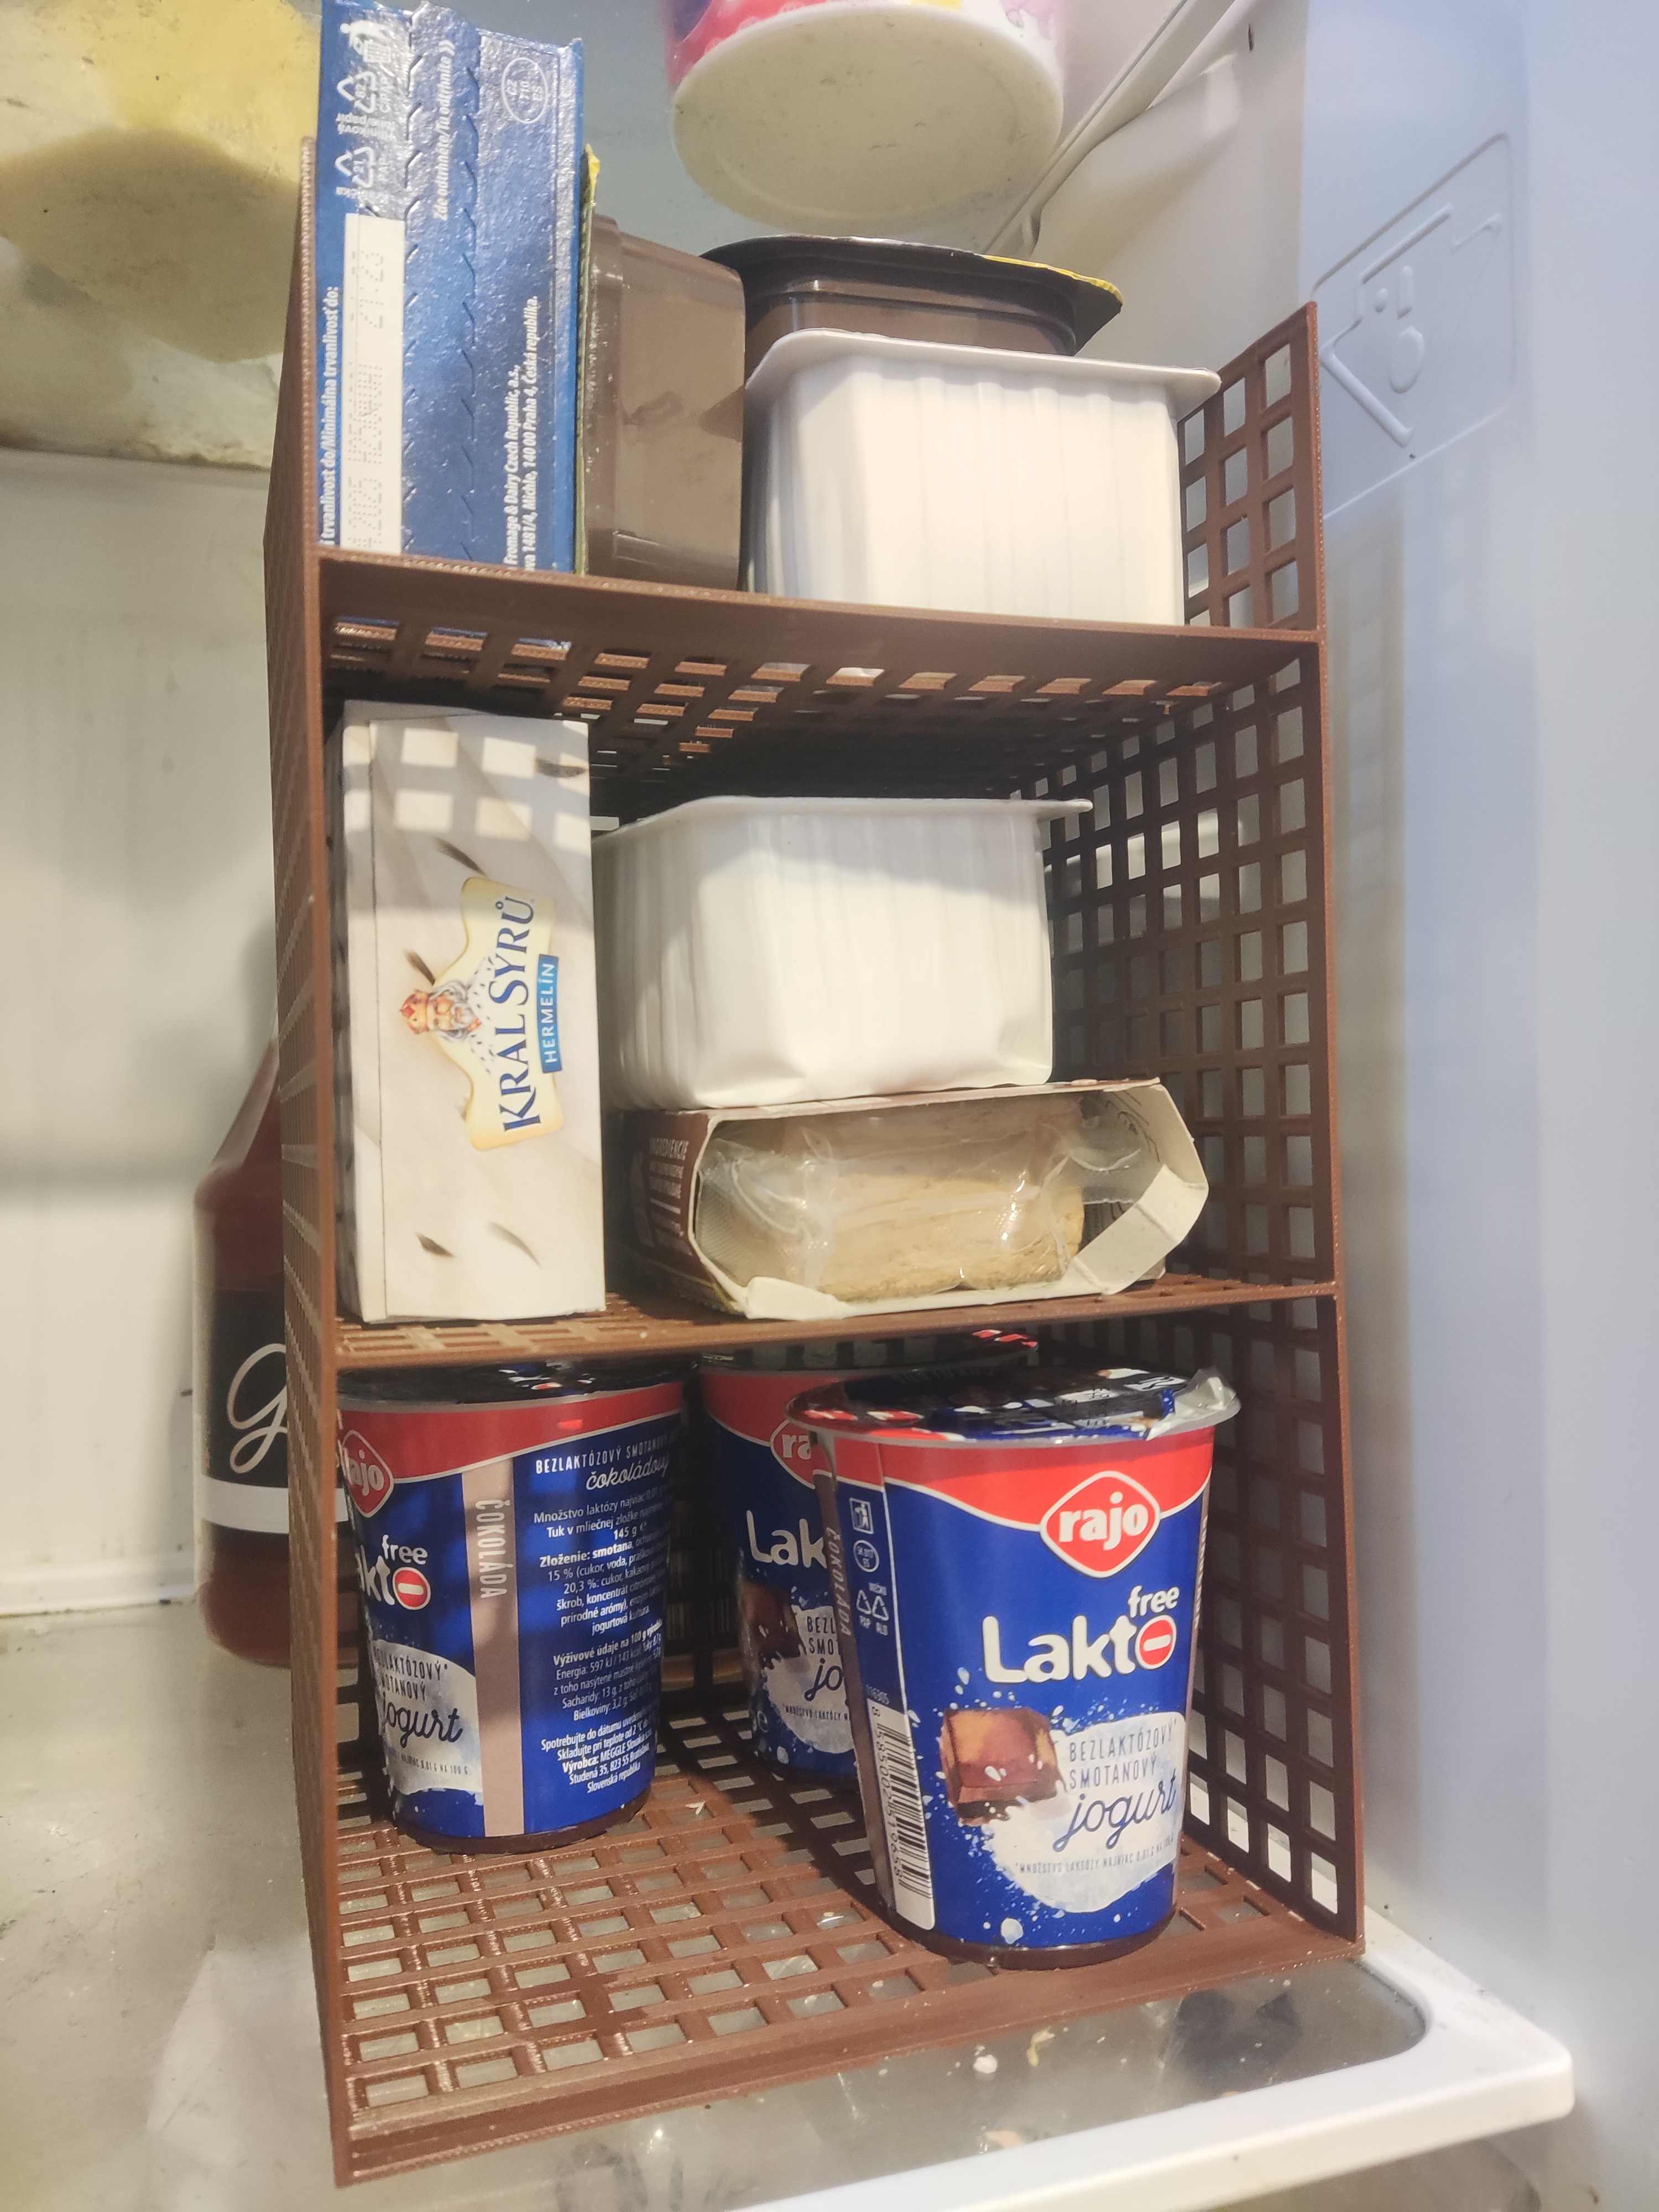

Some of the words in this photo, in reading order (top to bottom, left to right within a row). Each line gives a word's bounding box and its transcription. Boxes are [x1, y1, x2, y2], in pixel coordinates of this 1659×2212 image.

[433, 199, 448, 221] Zde
[523, 296, 541, 351] republika.
[521, 352, 538, 384] Česká
[504, 389, 521, 440] Republic,
[522, 398, 537, 430] Praha
[522, 430, 536, 447] 00
[504, 441, 519, 473] Czech
[522, 447, 536, 468] 140
[320, 469, 336, 538] trvanlivost
[504, 475, 521, 503] Dairy
[521, 470, 539, 510] Michle,
[504, 516, 520, 565] Fromage
[539, 962, 557, 1064] HERMELÍN
[343, 1447, 384, 1496] ajo
[535, 1446, 622, 1474] BEZLAKTÓZOVÝ
[534, 1509, 584, 1524] Množstvo
[586, 1501, 618, 1516] laktózy
[546, 1525, 565, 1538] Tuk
[567, 1526, 573, 1535] v
[576, 1519, 614, 1535] mliečnej
[1058, 1491, 1149, 1551] rajo
[381, 1533, 429, 1566] free
[474, 1499, 514, 1599] ČOKOLÁDA
[613, 1527, 629, 1541] 145
[632, 1526, 637, 1537] g
[539, 1550, 591, 1568] Zloženie:
[547, 1571, 560, 1582] 15
[563, 1568, 574, 1579] %
[606, 1555, 628, 1570] voda,
[563, 1581, 585, 1595] 20,3
[1128, 1584, 1180, 1618] free
[560, 1606, 599, 1628] prírodné
[591, 1615, 628, 1636] jogurtová
[553, 1647, 594, 1668] Výživové
[597, 1640, 619, 1656] údaje
[620, 1638, 629, 1648] na
[589, 1660, 604, 1673] 597
[554, 1687, 559, 1696] z
[560, 1681, 579, 1694] toho
[541, 1732, 586, 1752] Spotrebujte
[586, 1728, 597, 1740] do
[597, 1720, 622, 1738] dátumu
[556, 1745, 592, 1761] Skladujte
[592, 1739, 602, 1755] pri
[603, 1733, 624, 1749] teplote
[624, 1726, 633, 1739] od
[562, 1755, 599, 1775] Výrobca:
[600, 1743, 626, 1762] MEGGLE
[569, 1767, 598, 1785] Studená
[609, 1757, 622, 1772] 823
[1069, 1751, 1158, 1790] SMOTANOVÝ
[587, 1773, 618, 1793] Slovenská
[1052, 1767, 1178, 1853] jogurt
